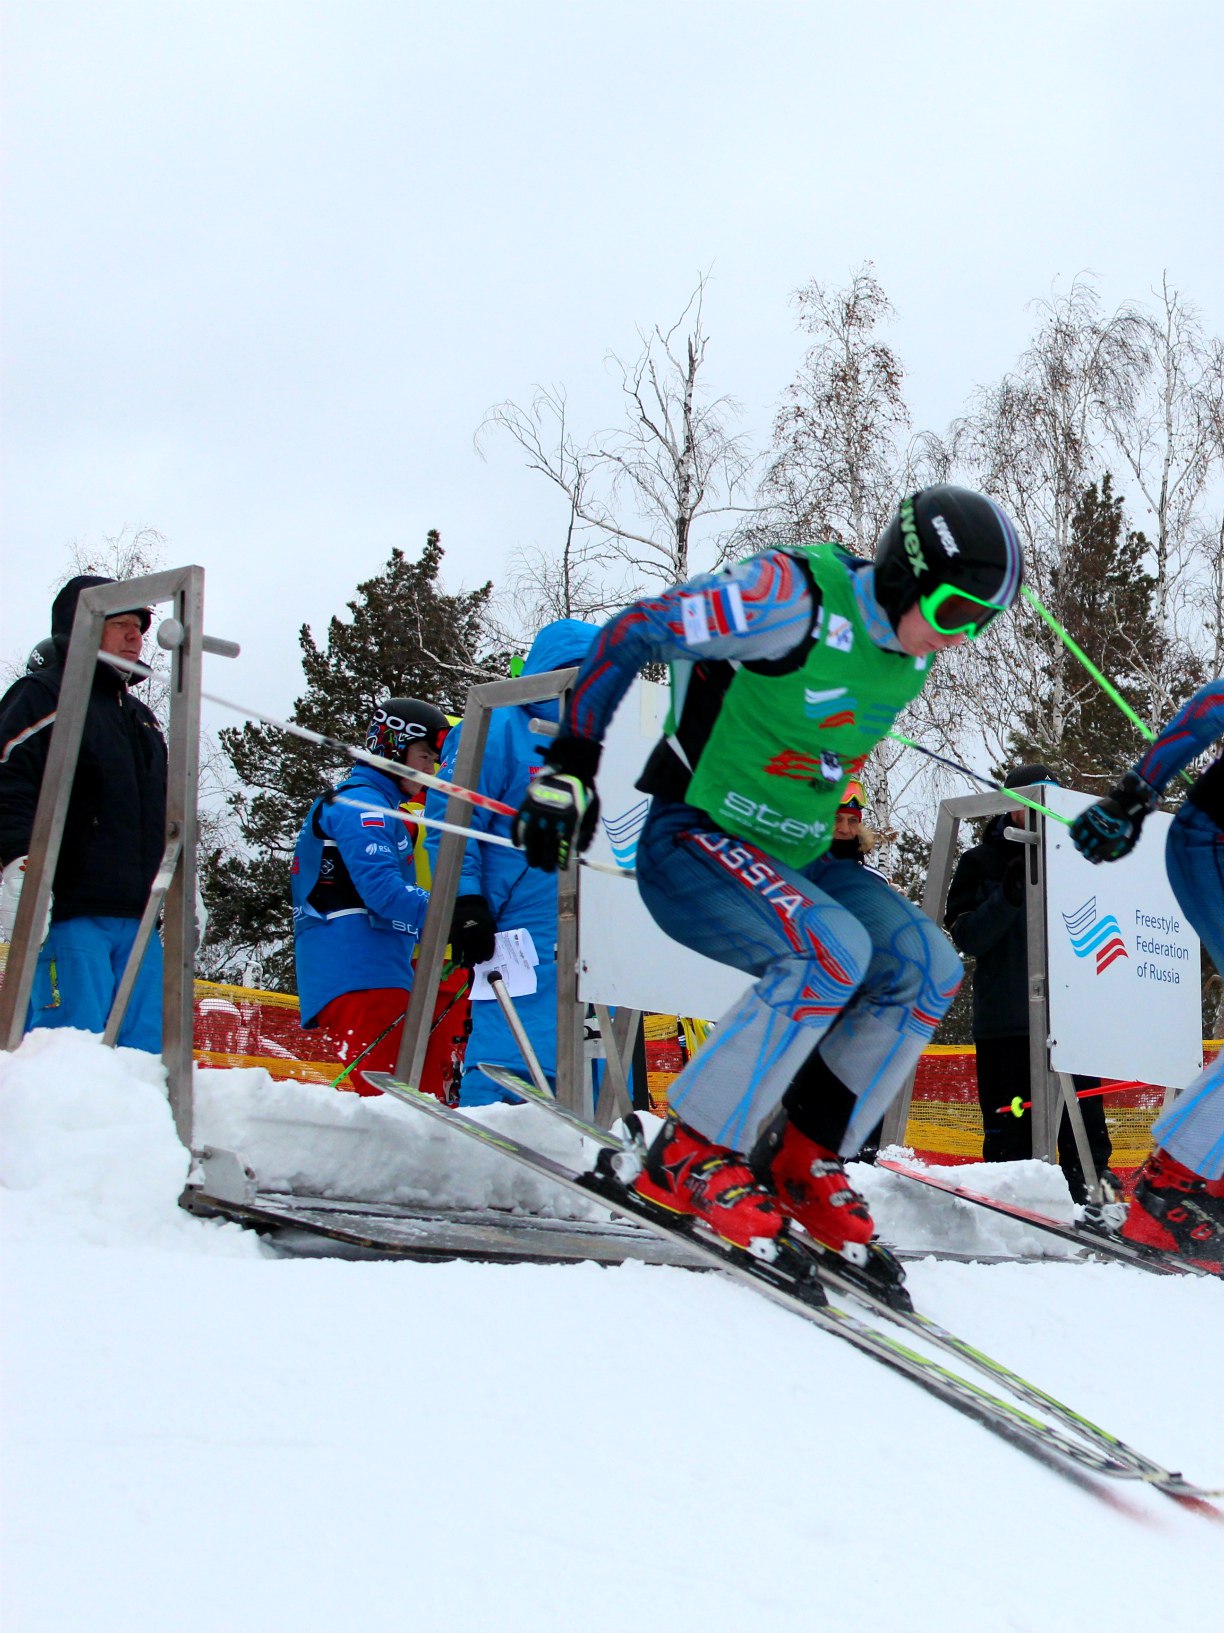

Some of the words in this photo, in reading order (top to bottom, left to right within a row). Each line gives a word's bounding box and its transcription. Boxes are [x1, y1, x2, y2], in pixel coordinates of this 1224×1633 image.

[1135, 909, 1180, 935] Freestyle
[1136, 935, 1189, 960] Federation
[1136, 961, 1148, 978] of
[1149, 963, 1180, 984] Russia
